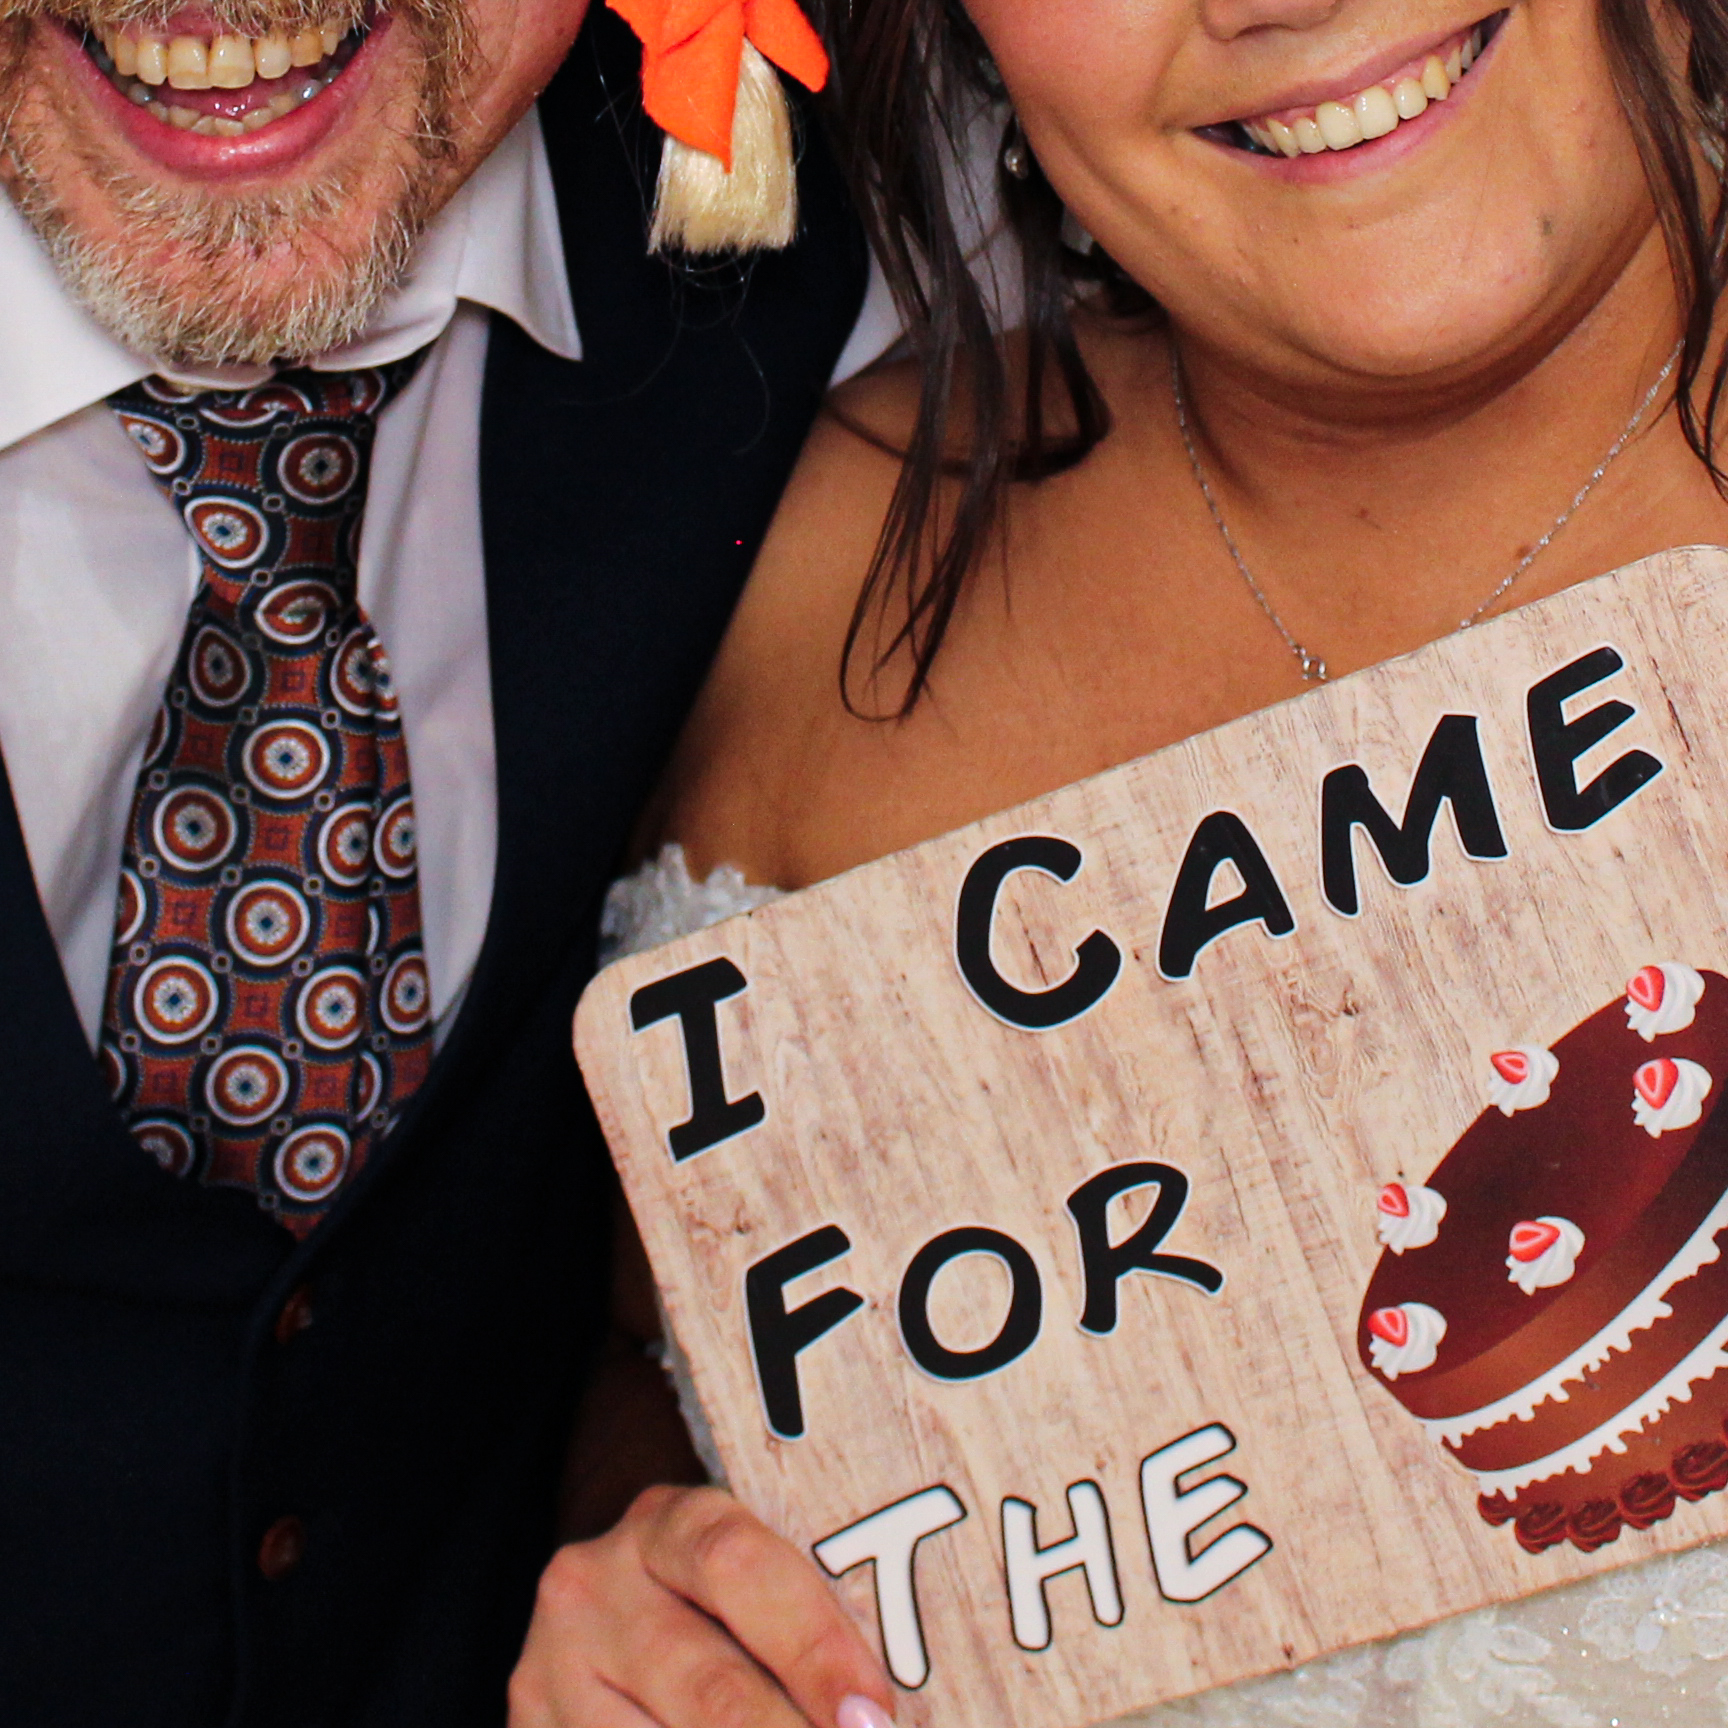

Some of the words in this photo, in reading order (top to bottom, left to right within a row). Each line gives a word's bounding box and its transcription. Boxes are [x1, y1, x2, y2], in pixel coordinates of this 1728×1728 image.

[629, 957, 767, 1163] I
[955, 642, 1665, 1032] CAME
[744, 1161, 1226, 1441] FOR
[812, 1422, 1273, 1691] THE
